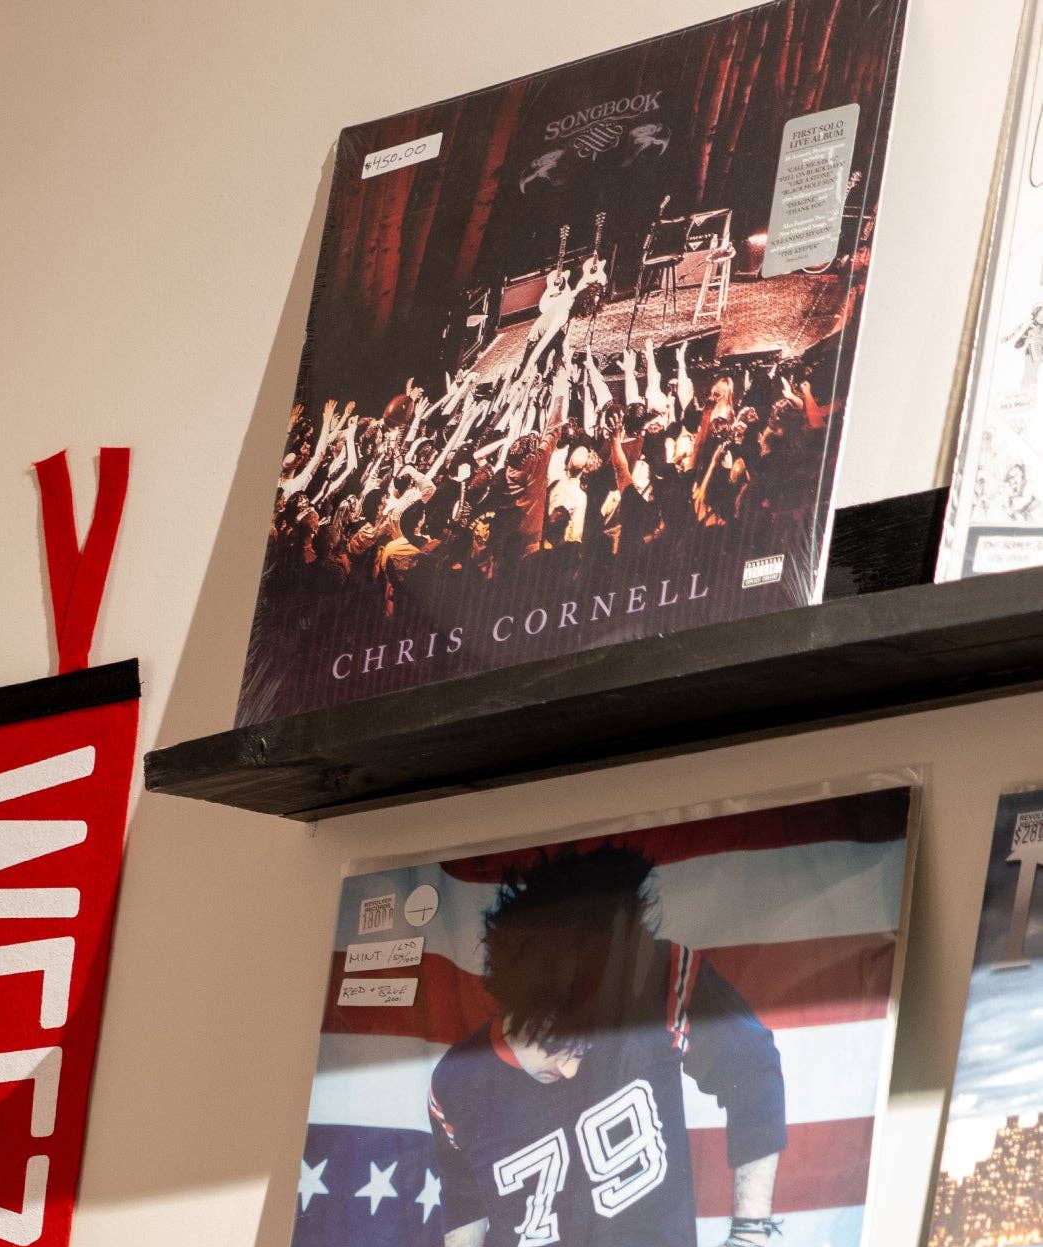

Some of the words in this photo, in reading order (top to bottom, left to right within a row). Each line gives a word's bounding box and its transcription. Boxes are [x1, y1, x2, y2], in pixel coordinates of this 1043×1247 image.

[545, 92, 662, 141] SONGBOOK
[790, 138, 810, 149] LIVE
[813, 130, 844, 143] ALBUM
[793, 126, 818, 140] FIRST
[819, 120, 844, 133] SOLO
[365, 143, 427, 171] $450.00
[330, 627, 462, 680] CHRIS
[491, 572, 710, 642] CORNELL
[349, 951, 382, 963] MINT
